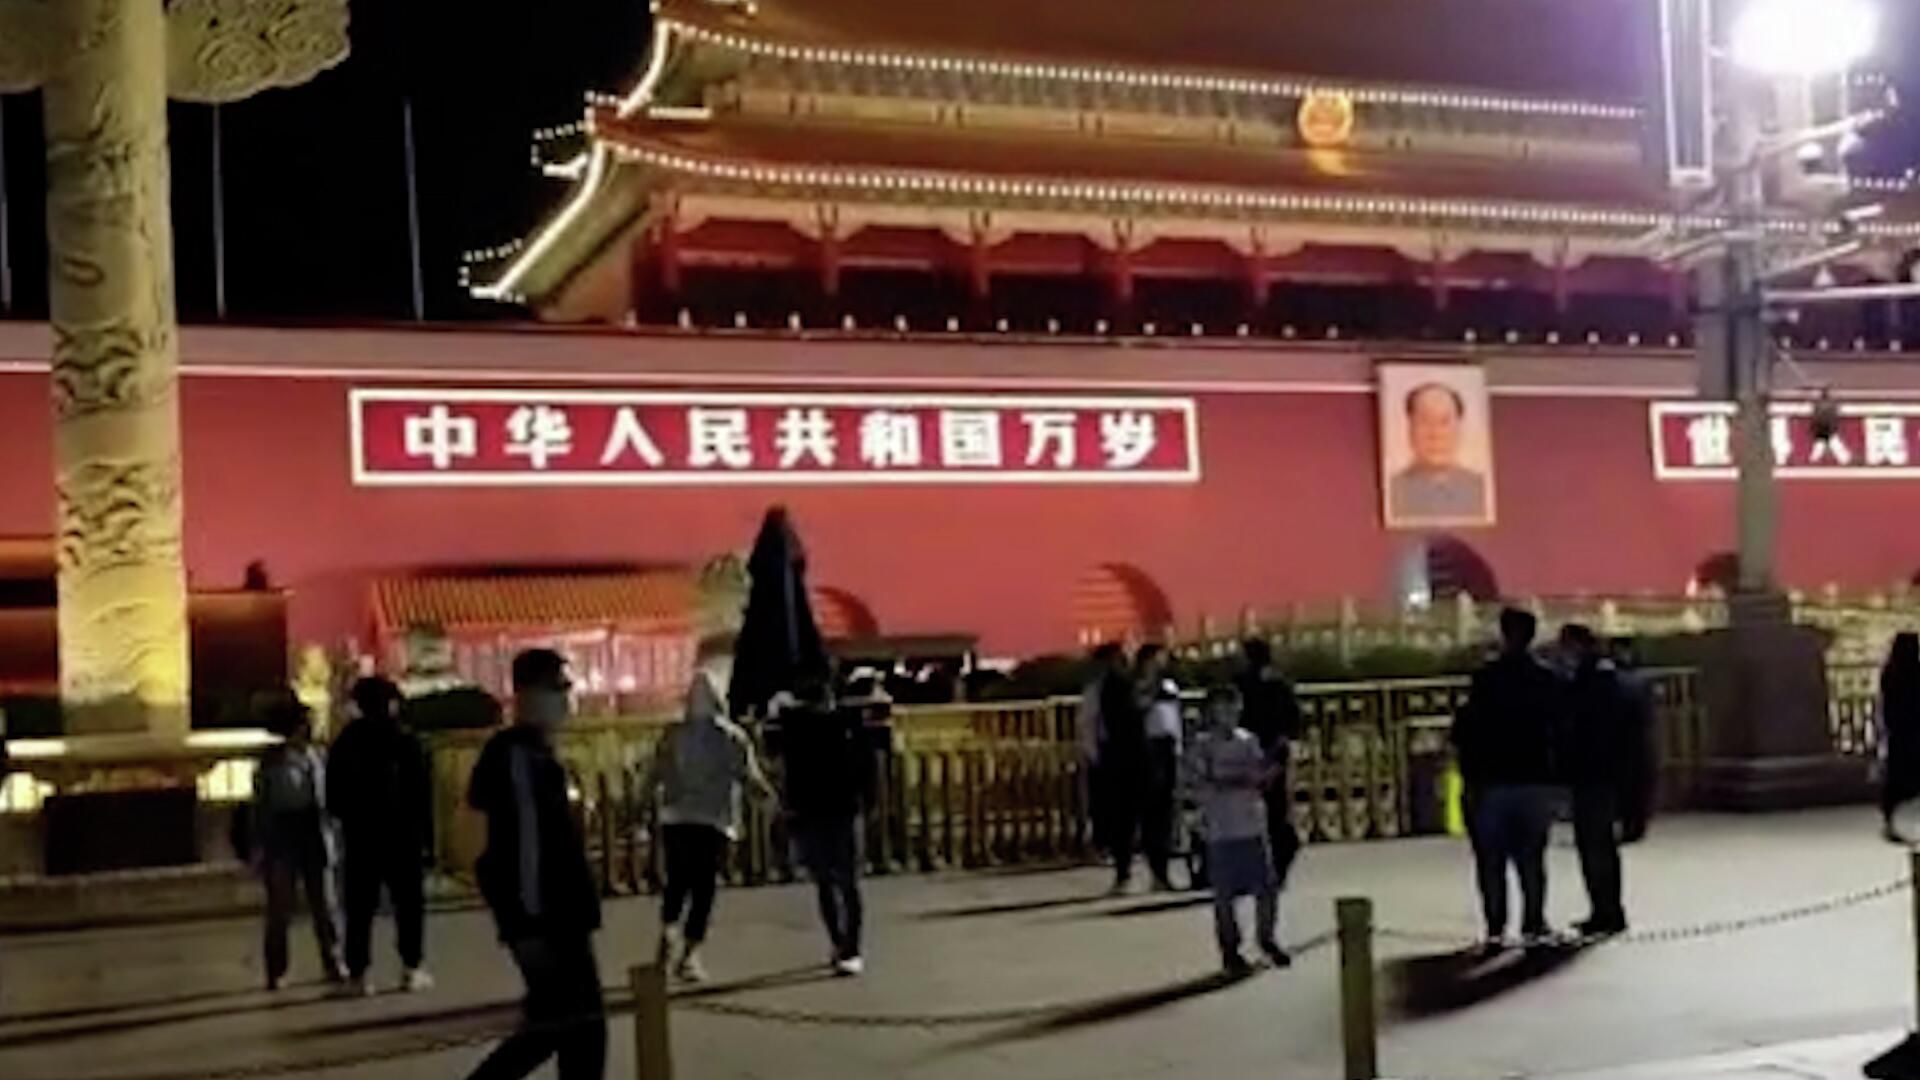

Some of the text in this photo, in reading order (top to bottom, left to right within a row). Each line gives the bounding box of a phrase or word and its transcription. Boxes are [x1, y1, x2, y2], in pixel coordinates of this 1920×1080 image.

[404, 405, 1158, 468] 中华人民共和国万岁
